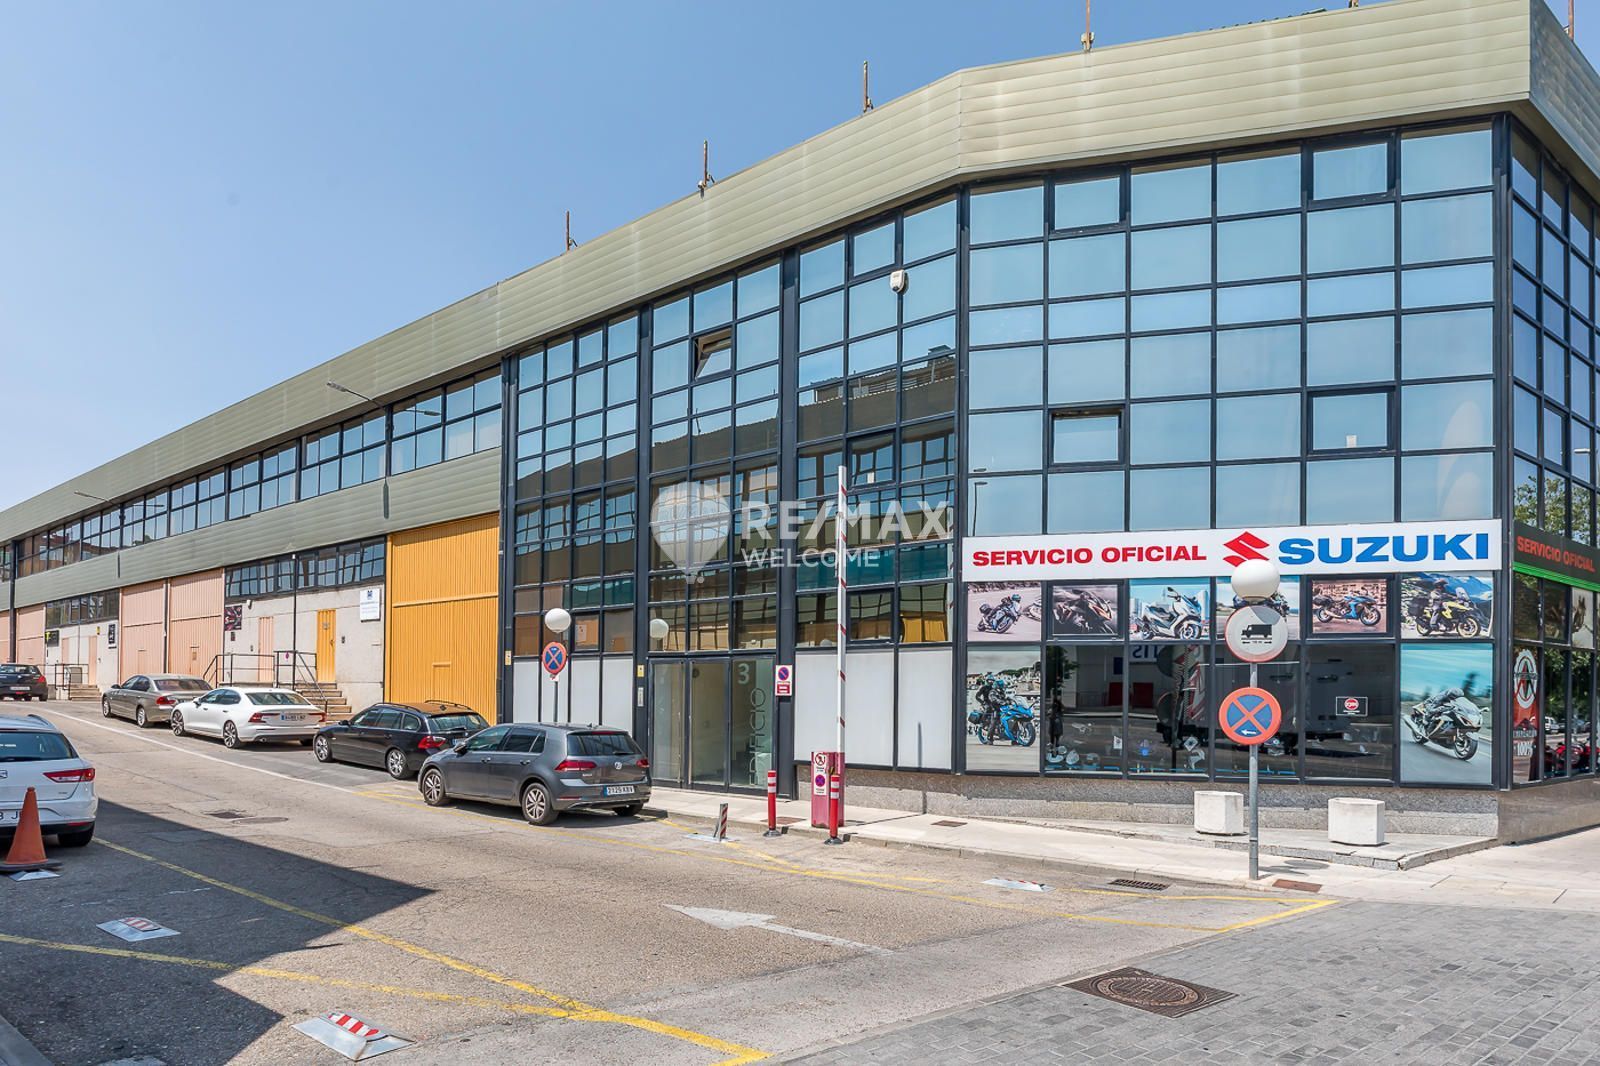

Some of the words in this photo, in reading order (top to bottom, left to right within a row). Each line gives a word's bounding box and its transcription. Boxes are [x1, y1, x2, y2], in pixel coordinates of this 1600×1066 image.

[972, 547, 1094, 566] SERVICIO
[1101, 546, 1207, 563] OFICIAL
[1278, 531, 1489, 565] SUZUKI
[1516, 536, 1561, 562] SERVICIO
[1563, 551, 1595, 573] OFICIAL
[737, 663, 750, 685] 3
